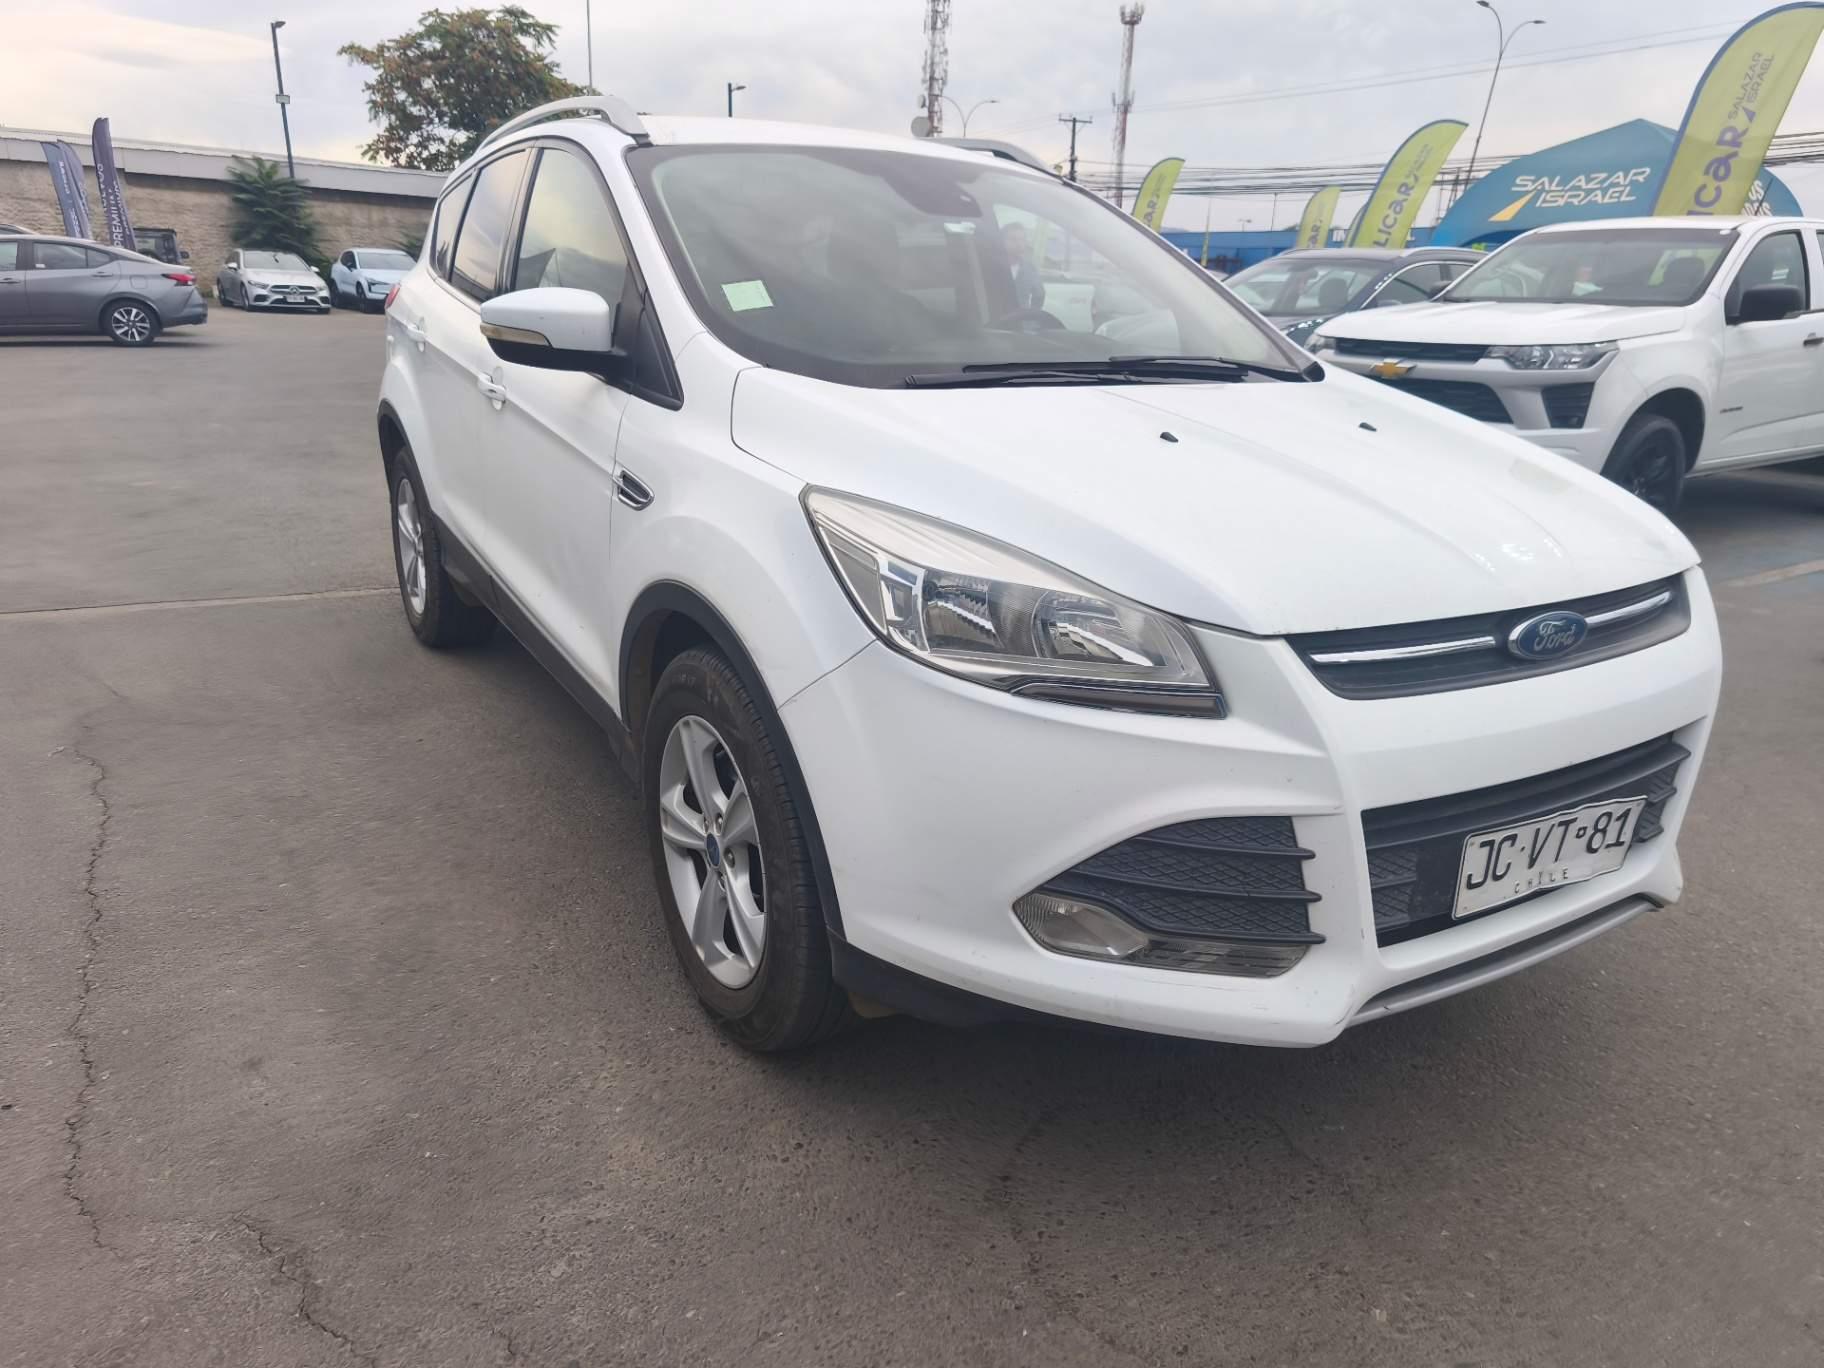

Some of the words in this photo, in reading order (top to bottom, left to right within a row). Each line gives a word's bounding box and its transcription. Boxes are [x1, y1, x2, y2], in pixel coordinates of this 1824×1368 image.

[1728, 52, 1762, 120] SALAZAR
[1746, 54, 1774, 103] ISRAEL
[1511, 167, 1650, 191] SALAZAR
[1536, 186, 1637, 207] ISRAEL
[1534, 619, 1577, 651] Ford
[1514, 868, 1569, 894] CHILE
